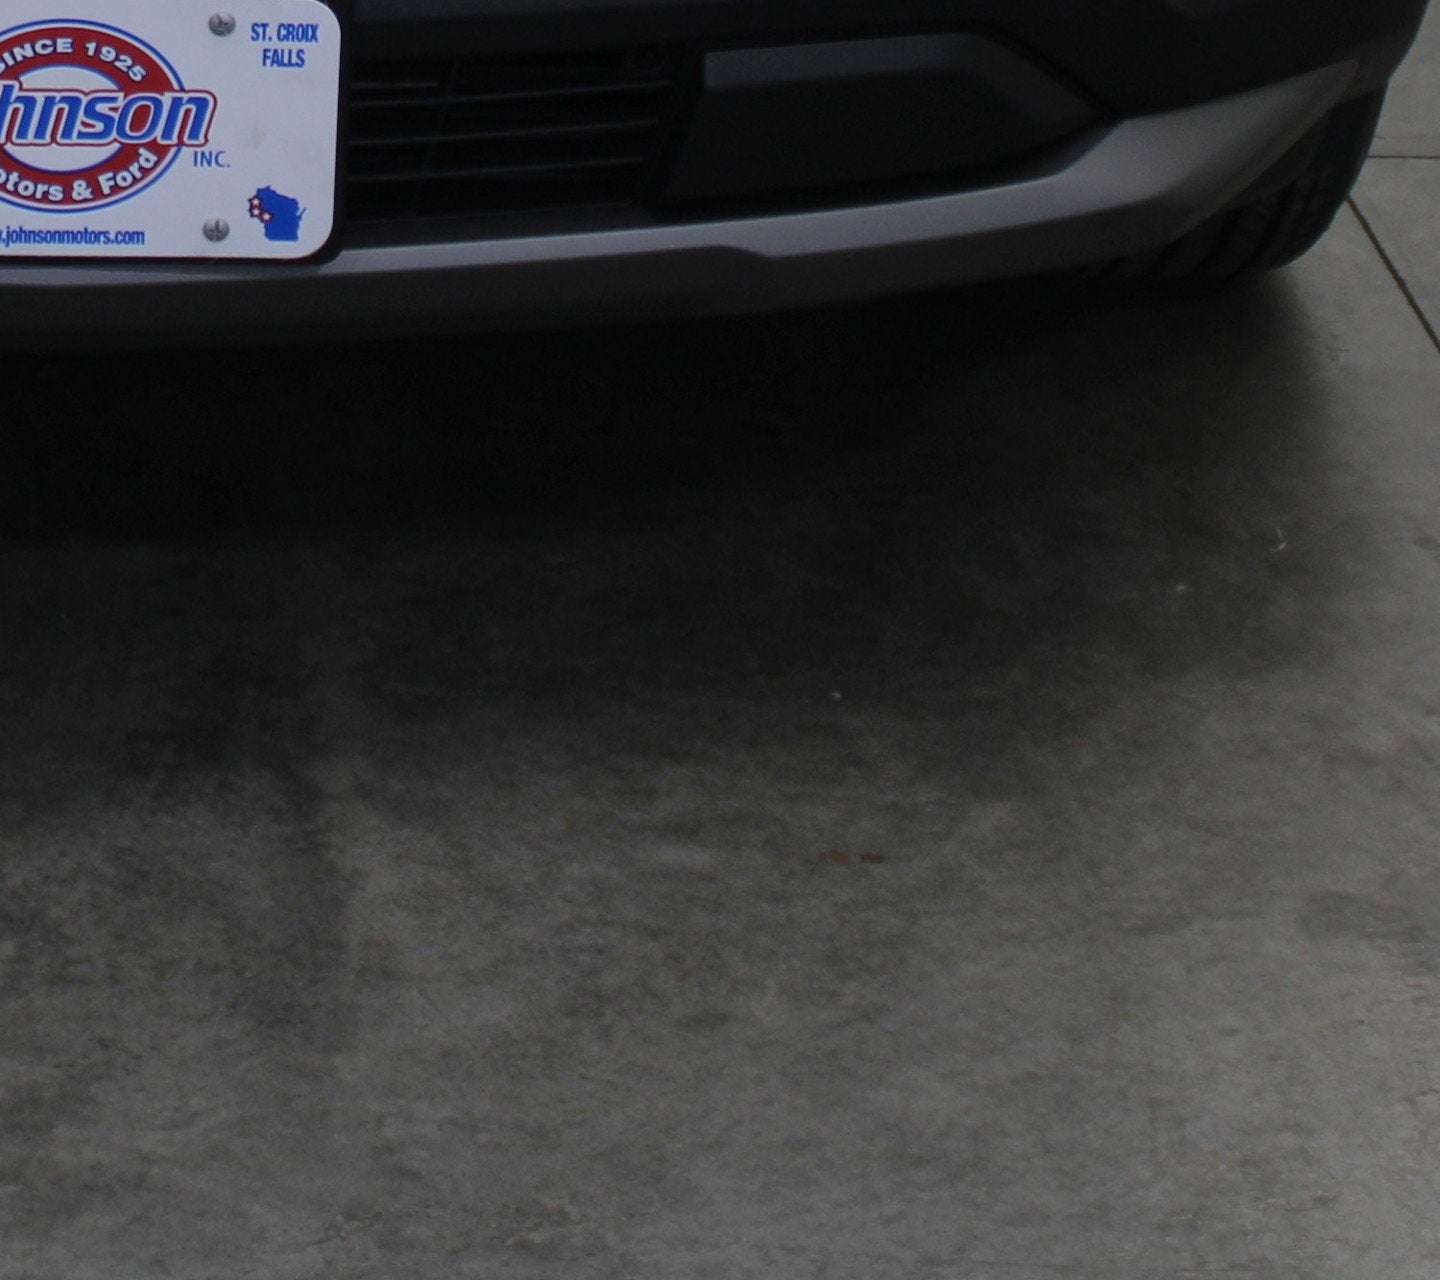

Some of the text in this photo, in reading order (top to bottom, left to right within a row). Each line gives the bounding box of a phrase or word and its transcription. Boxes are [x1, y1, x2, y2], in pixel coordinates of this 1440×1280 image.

[250, 23, 319, 43] ST. CROIX
[85, 41, 147, 83] 1925
[262, 49, 305, 68] FALLS
[192, 151, 230, 168] INC.
[71, 181, 94, 201] &
[98, 148, 158, 196] Ford
